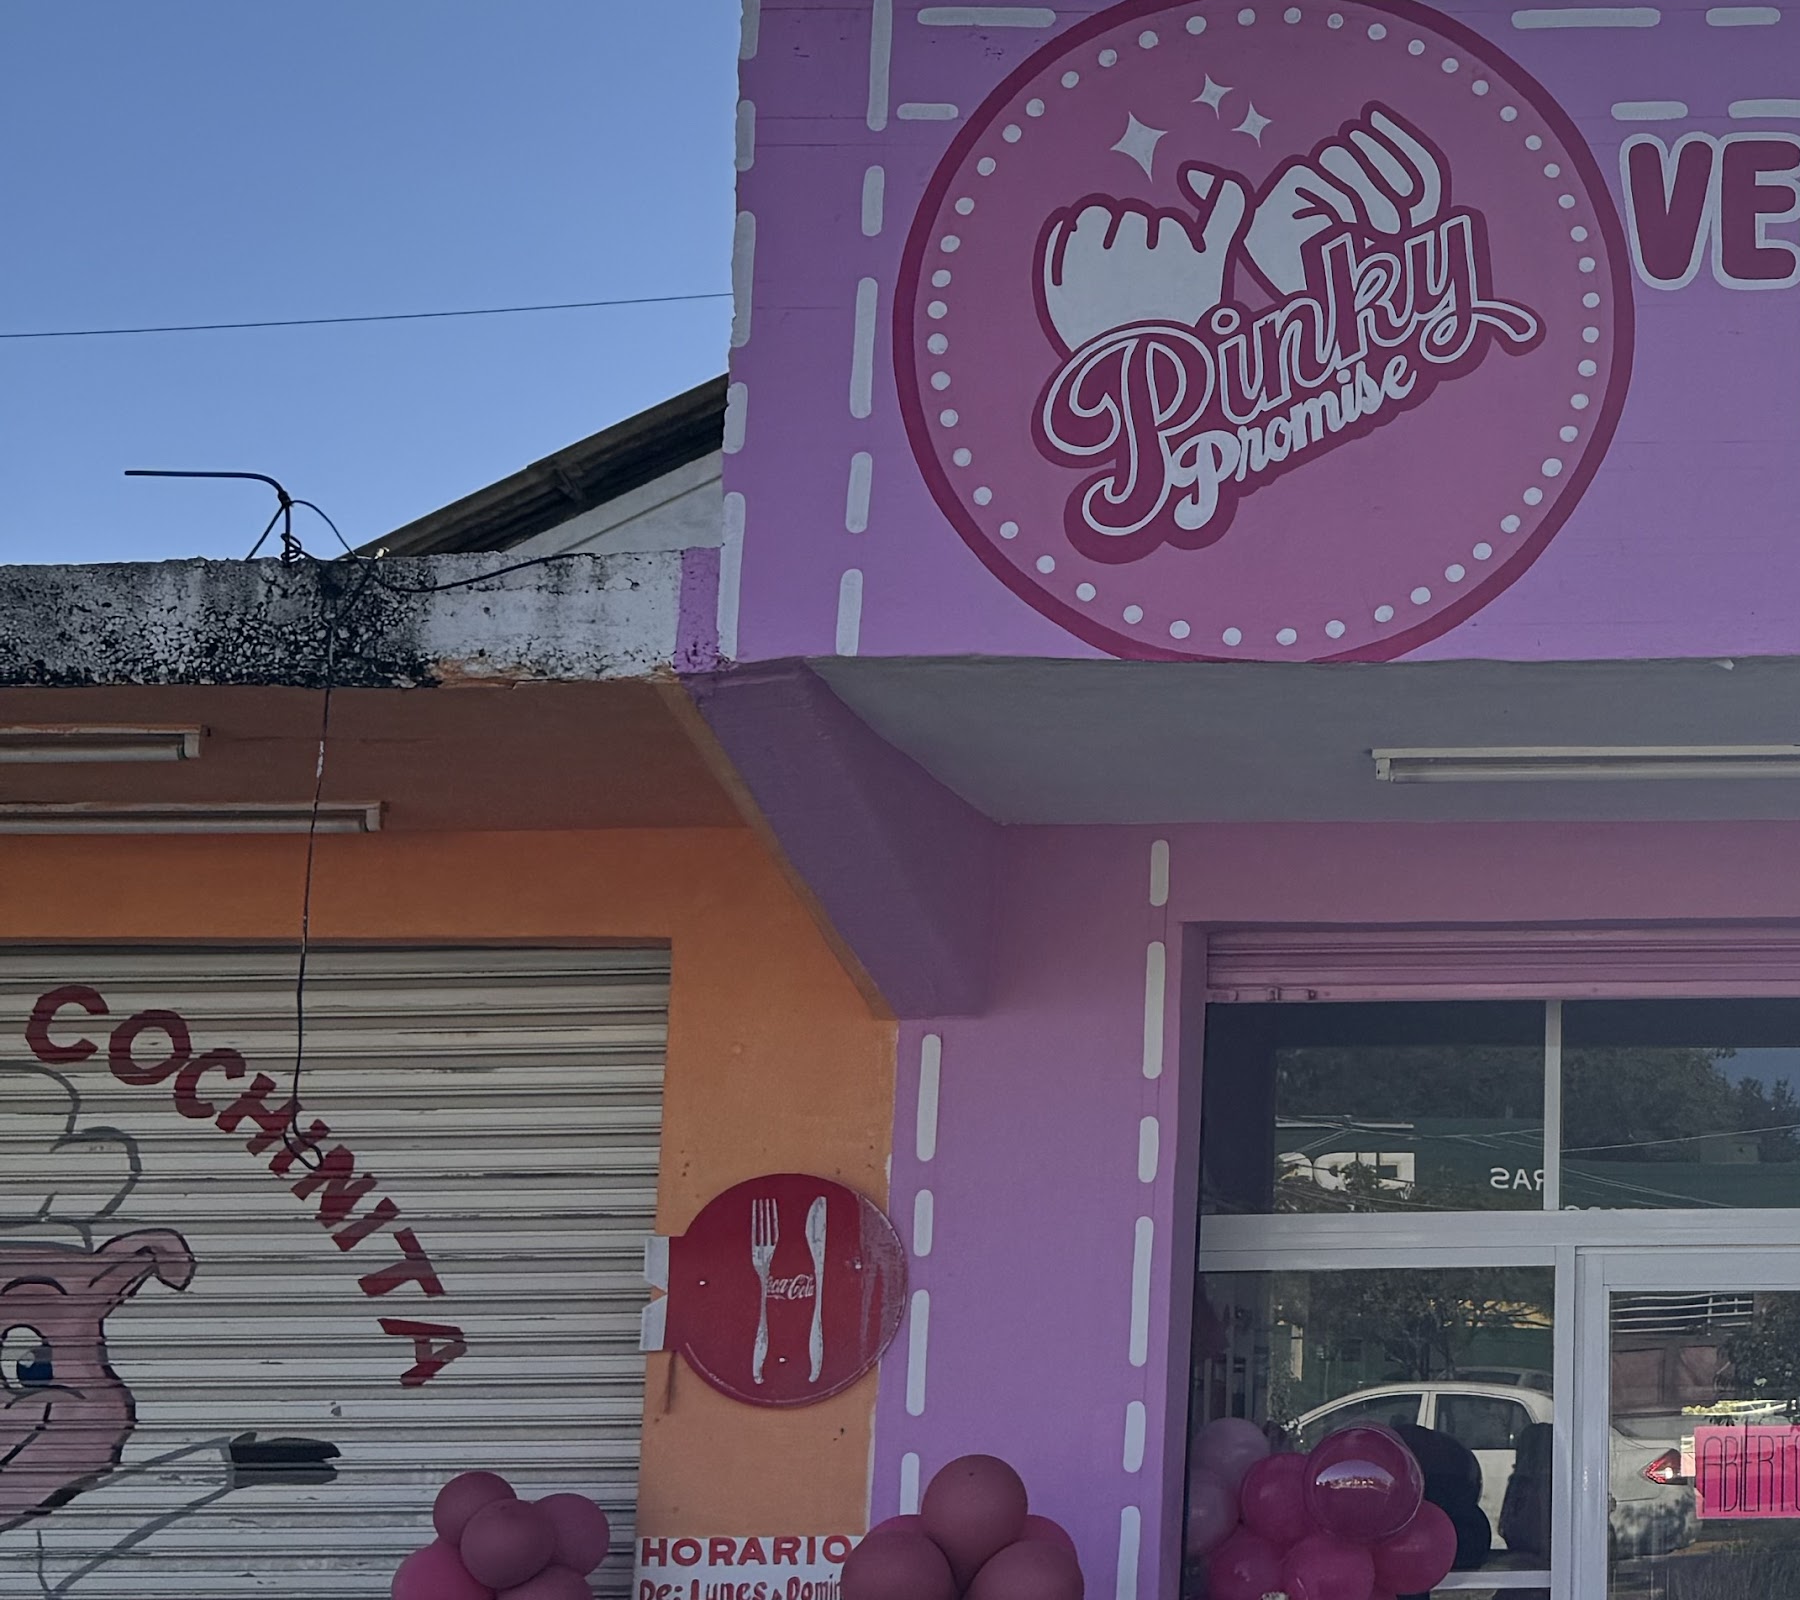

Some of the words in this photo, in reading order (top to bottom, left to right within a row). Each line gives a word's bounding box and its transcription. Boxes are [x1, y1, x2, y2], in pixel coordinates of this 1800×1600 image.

[1042, 214, 1538, 536] Pinky
[1169, 353, 1418, 531] Promise
[25, 984, 469, 1388] COCHINITA
[641, 1534, 854, 1567] HORARIO
